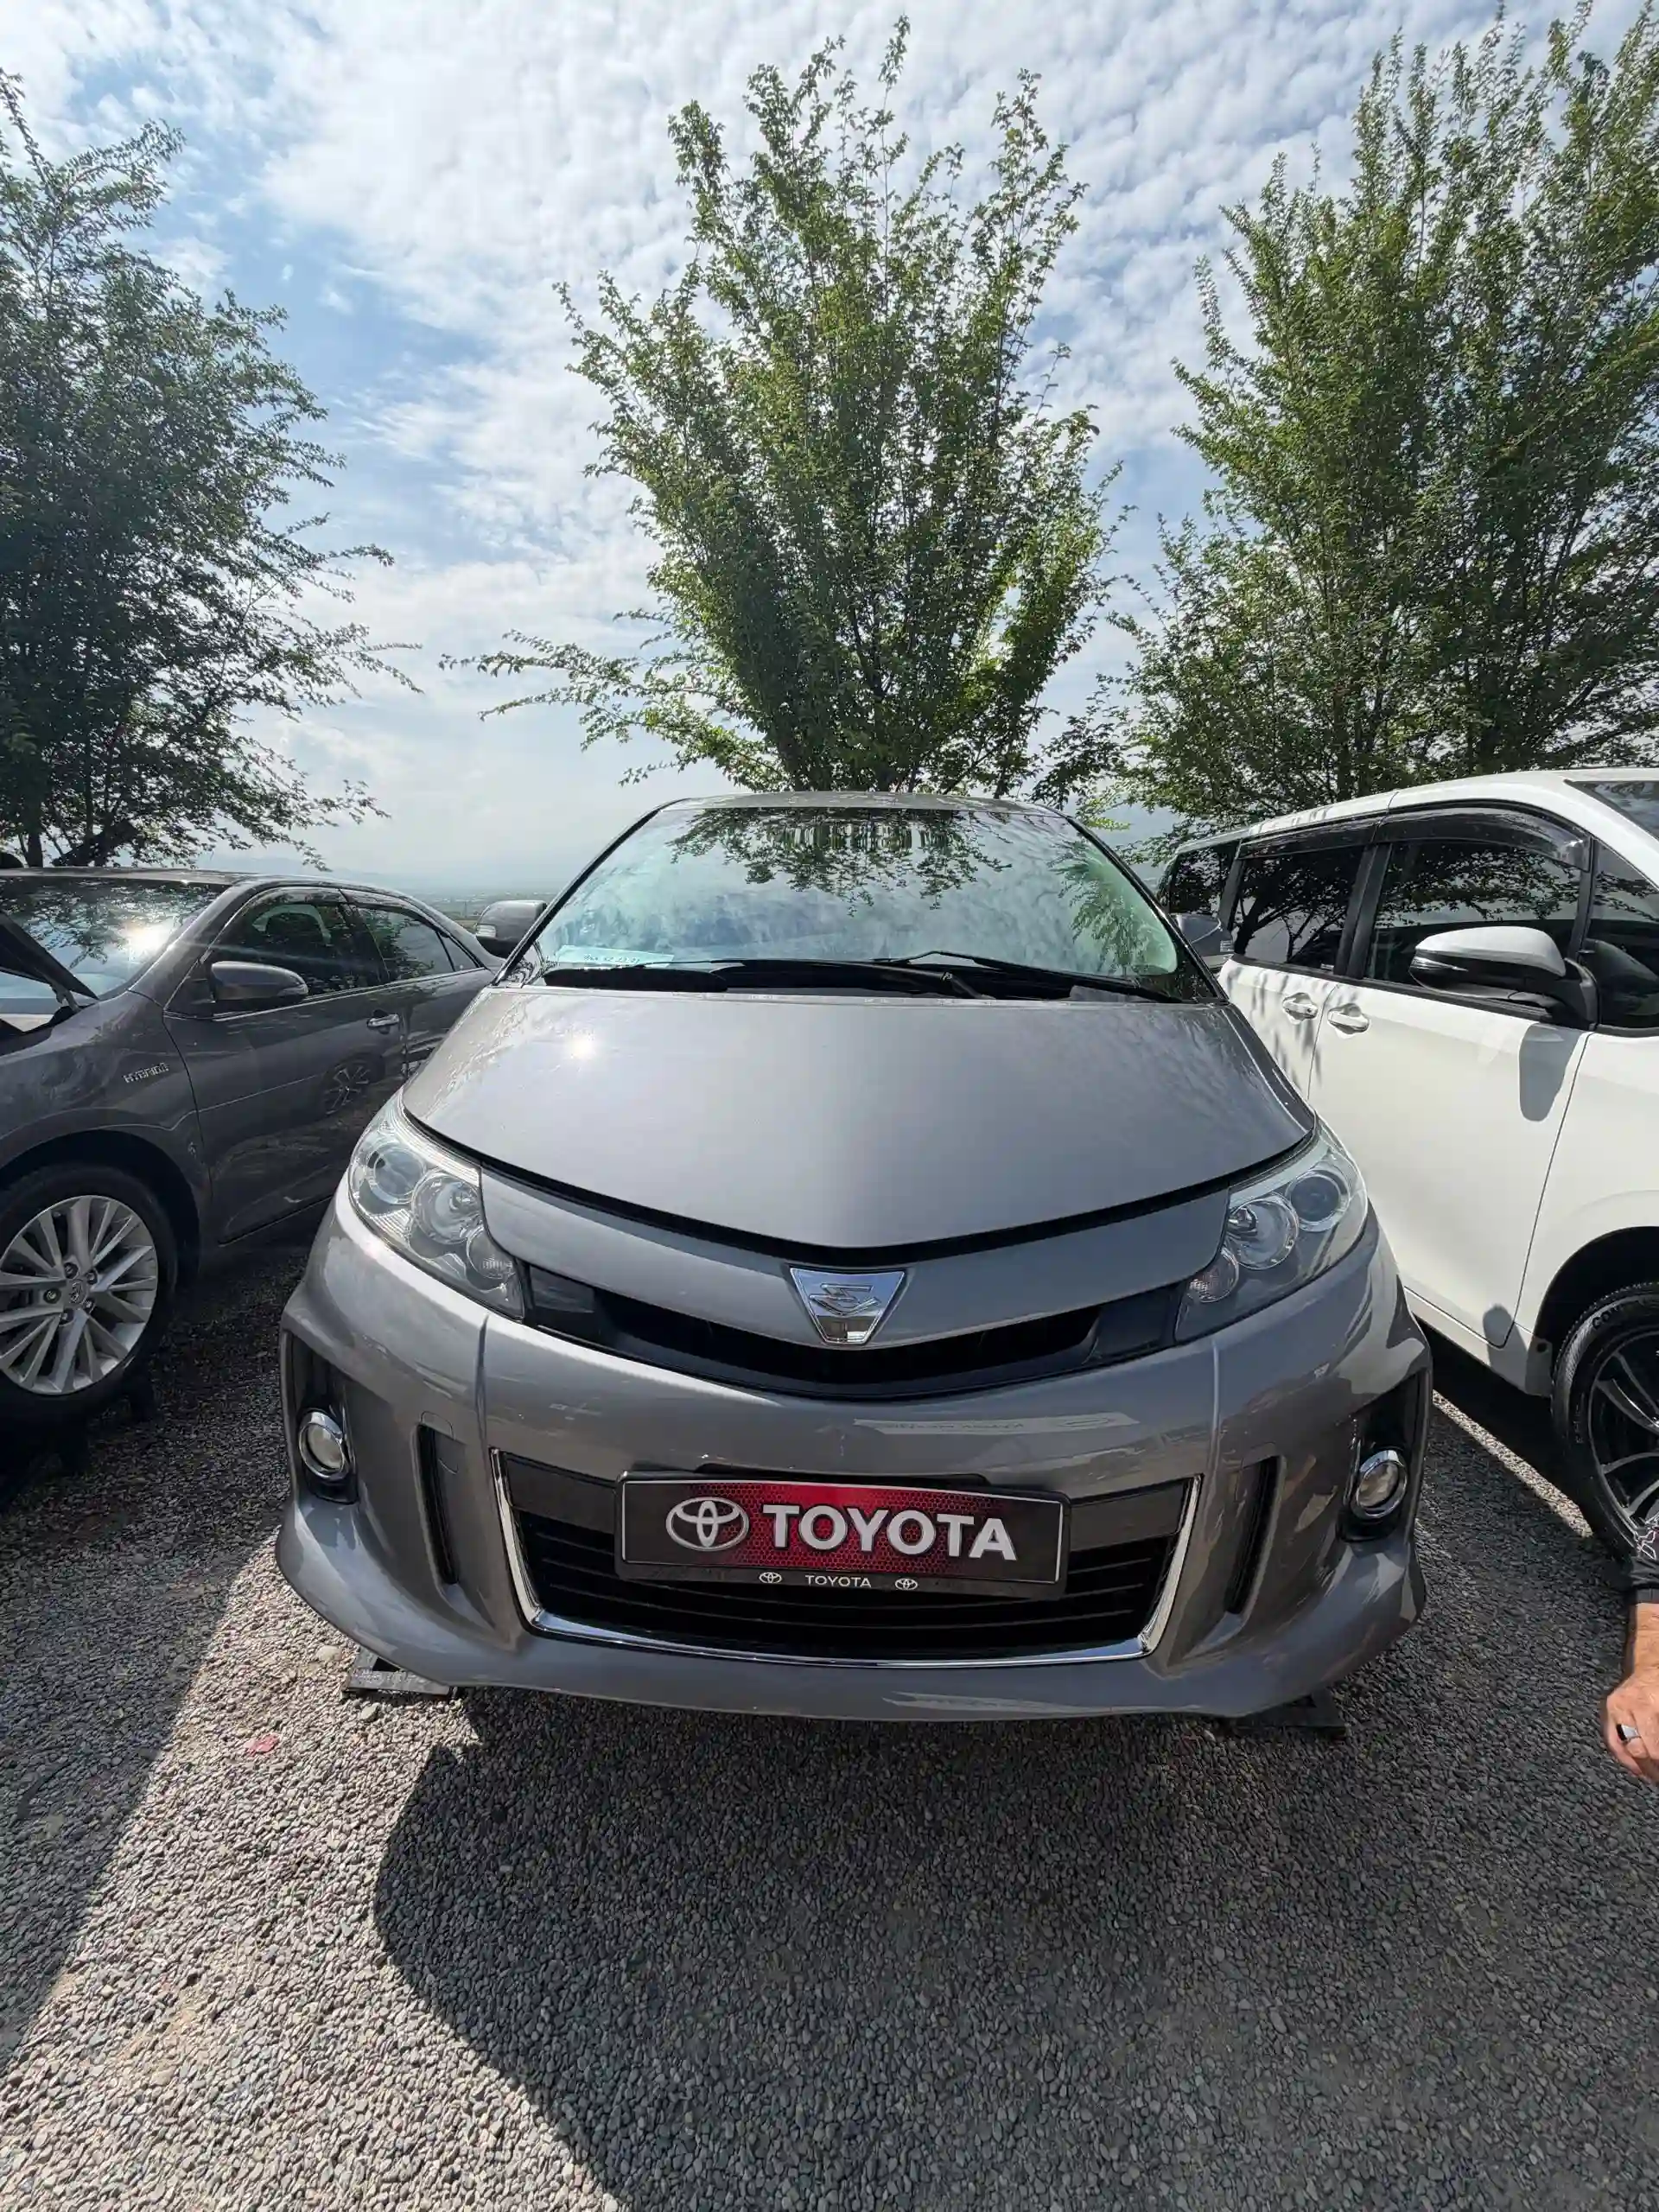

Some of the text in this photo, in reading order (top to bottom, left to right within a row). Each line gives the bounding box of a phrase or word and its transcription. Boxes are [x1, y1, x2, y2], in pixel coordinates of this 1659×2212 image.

[123, 1062, 169, 1084] HYBRID
[762, 1503, 1017, 1561] TOYOTA
[804, 1574, 872, 1588] TOYOTA
